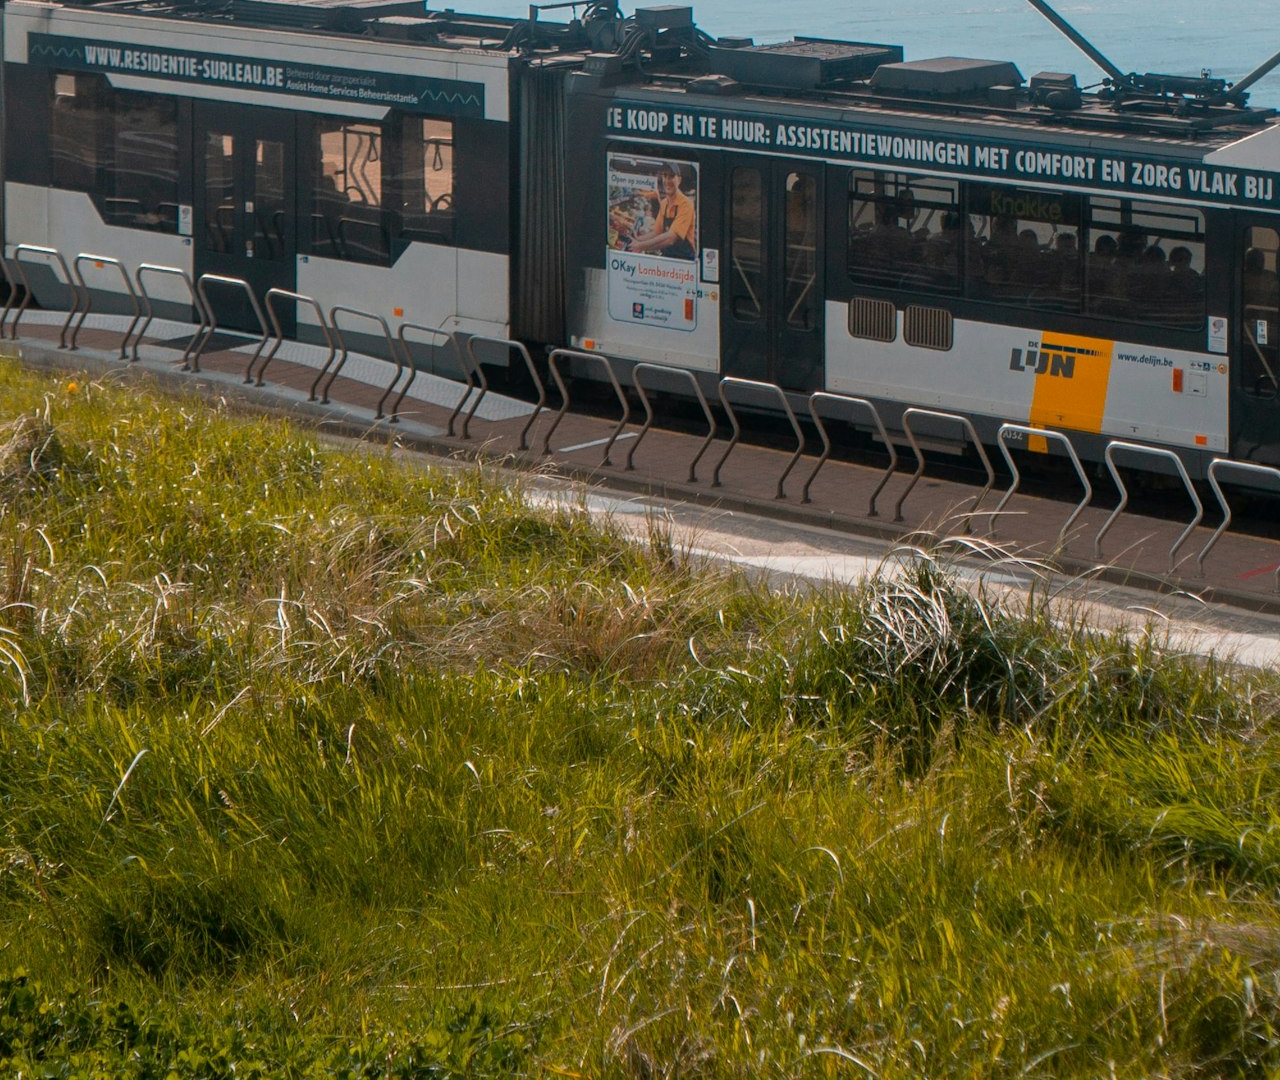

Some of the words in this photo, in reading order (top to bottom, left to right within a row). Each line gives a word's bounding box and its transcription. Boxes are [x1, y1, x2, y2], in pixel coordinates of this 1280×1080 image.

[84, 45, 283, 88] WWW.RESIDENTIE-SURLEAU.BE
[286, 80, 307, 91] Assist
[308, 82, 329, 94] Home
[329, 85, 358, 98] Services
[627, 109, 668, 133] KOOP
[673, 113, 694, 137] EN
[698, 116, 717, 139] TE
[722, 119, 771, 144] HUUR:
[775, 124, 969, 167] ASSISTENTIEWONINGEN
[974, 145, 1009, 171] MET
[1015, 150, 1096, 180] COMFORT
[1101, 159, 1126, 184] EN
[1131, 161, 1182, 190] ZORG
[1188, 168, 1238, 197] VLAK
[1244, 175, 1273, 201] BIJ
[611, 258, 636, 277] OKay
[638, 263, 695, 284] Lombardsijde
[1117, 352, 1174, 368] www.delijn.be
